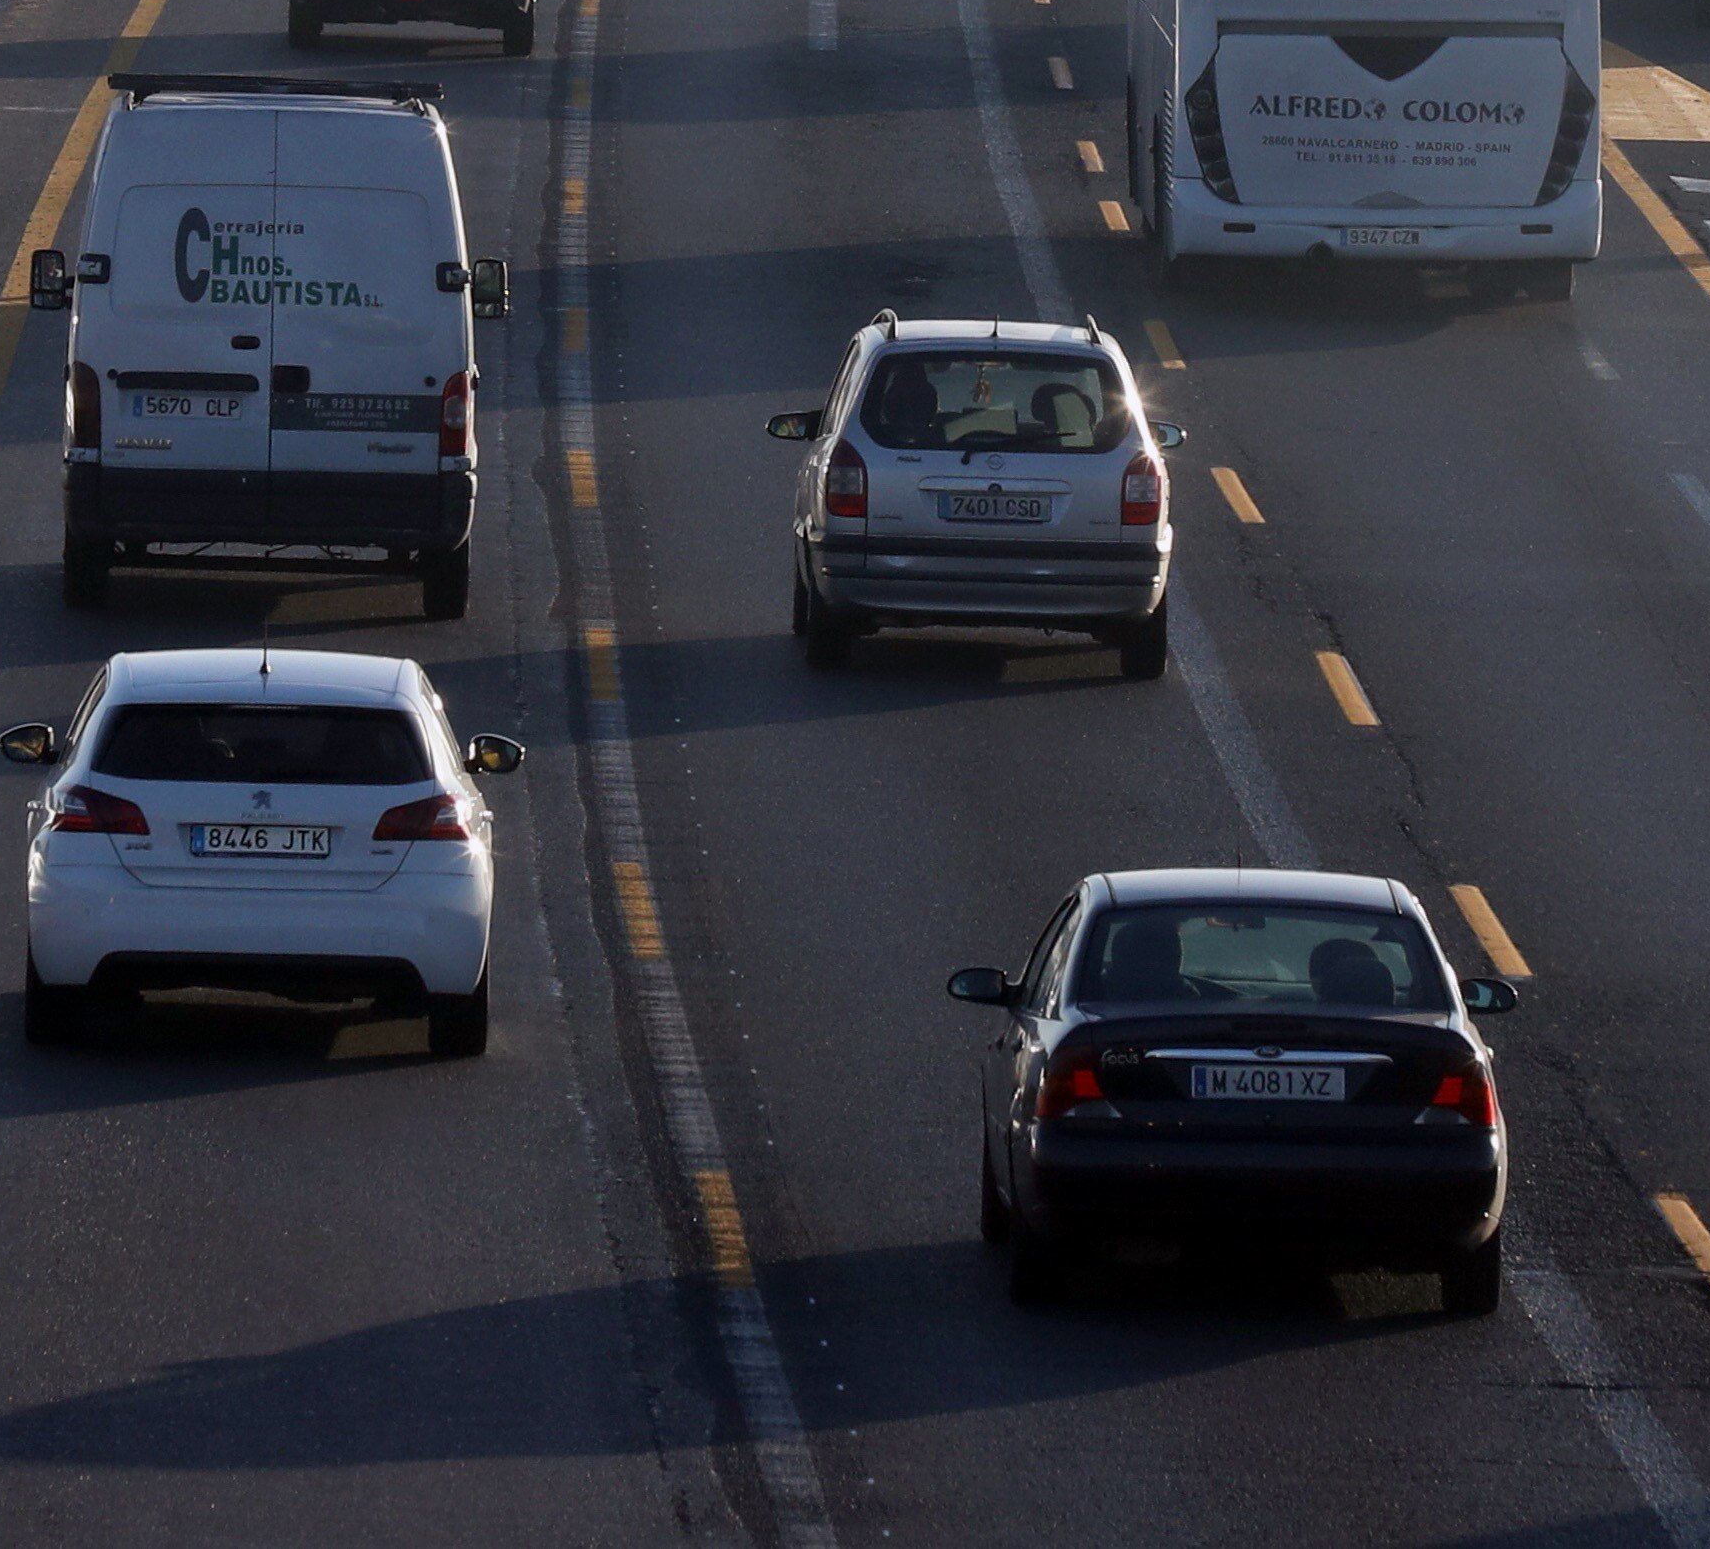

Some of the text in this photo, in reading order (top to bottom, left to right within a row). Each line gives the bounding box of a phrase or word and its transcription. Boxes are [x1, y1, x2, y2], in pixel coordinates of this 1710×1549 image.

[1297, 136, 1399, 151] NAVALCARNERO
[1415, 141, 1465, 152] MADRID
[1475, 142, 1512, 154] SPAIN
[1349, 228, 1388, 245] 9347
[211, 235, 293, 277] Hnos.
[210, 279, 362, 308] BAUTISTA
[146, 397, 240, 417] 5670 CLP
[331, 398, 355, 410] 925
[953, 497, 1041, 518] 7401 CSD
[208, 828, 326, 851] 8446 JTK
[1212, 1070, 1227, 1094] M
